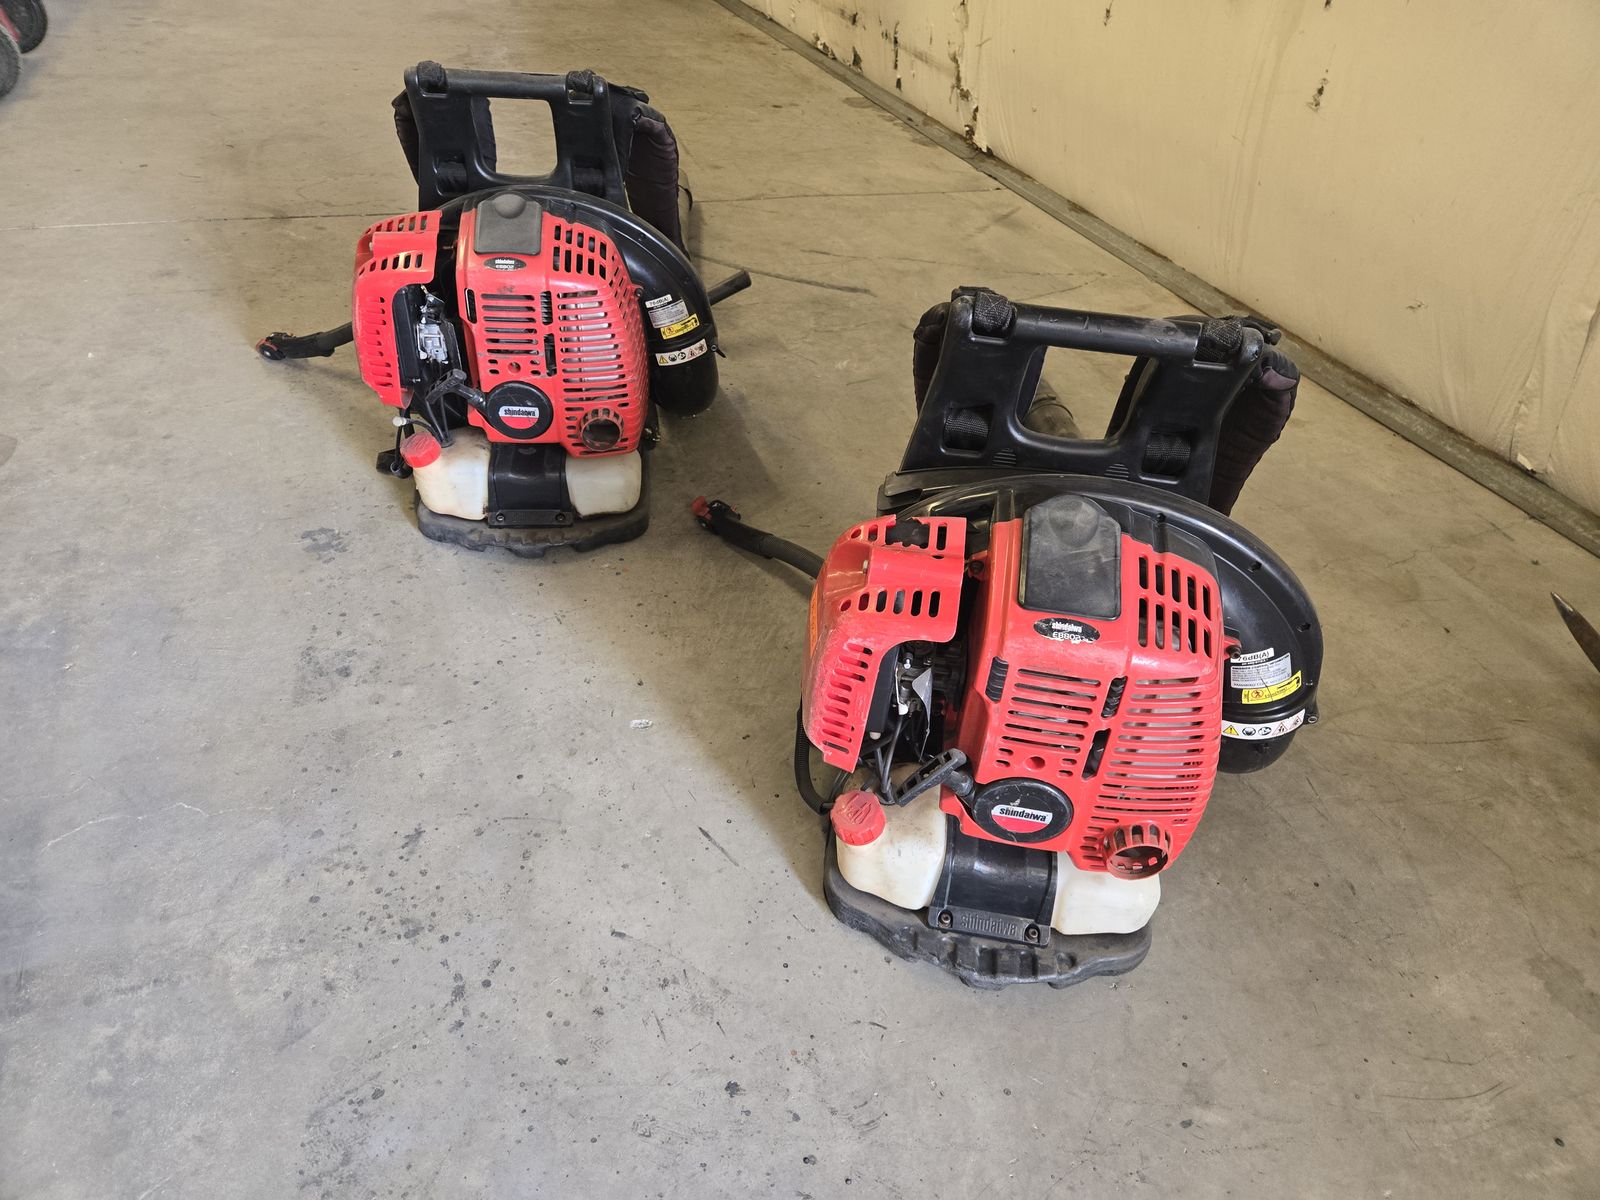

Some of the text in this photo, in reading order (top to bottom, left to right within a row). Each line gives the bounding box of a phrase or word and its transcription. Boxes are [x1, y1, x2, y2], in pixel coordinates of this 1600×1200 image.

[503, 407, 536, 417] shindaiwa
[999, 807, 1047, 822] shindaiwa
[961, 912, 1018, 937] shindaiwa
